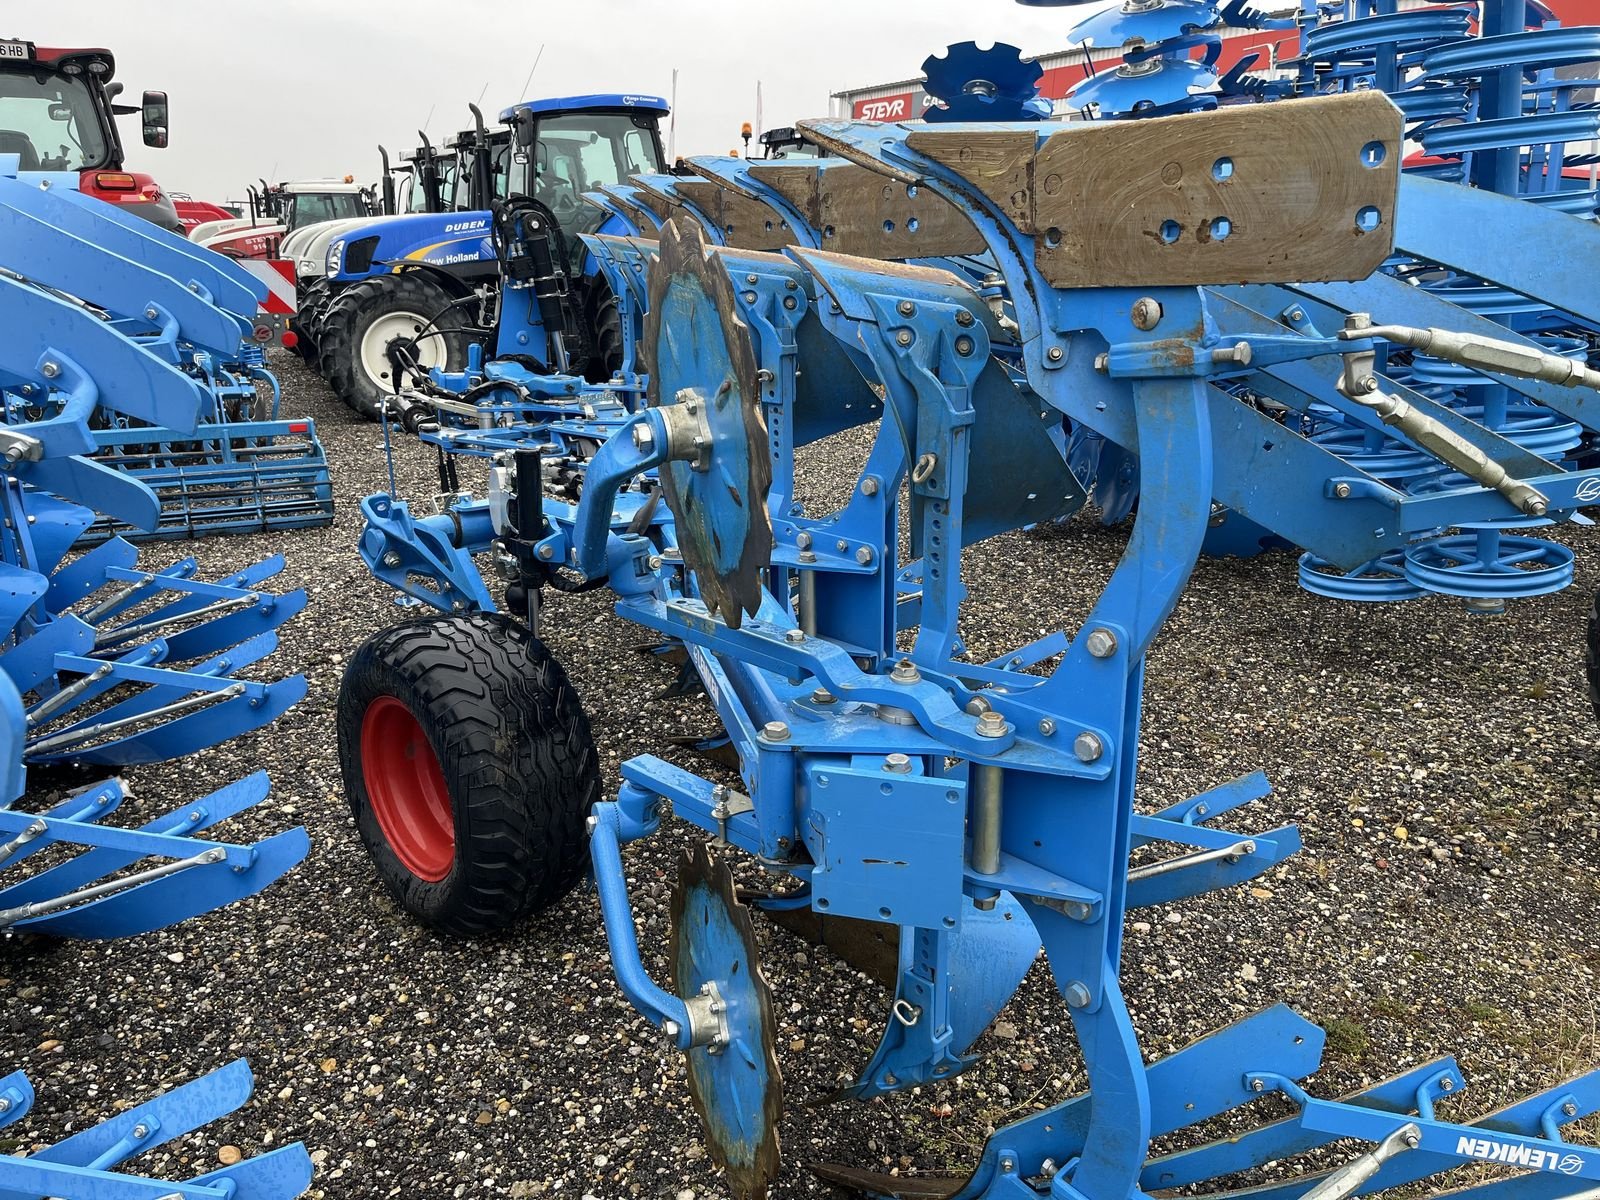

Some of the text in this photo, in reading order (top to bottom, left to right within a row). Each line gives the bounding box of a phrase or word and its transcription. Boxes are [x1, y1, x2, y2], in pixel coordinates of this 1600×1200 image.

[8, 45, 23, 57] HB
[860, 99, 905, 120] STEYR
[445, 220, 486, 233] DUBEN
[445, 251, 479, 264] Holland
[1455, 1136, 1559, 1171] LEMKEN
